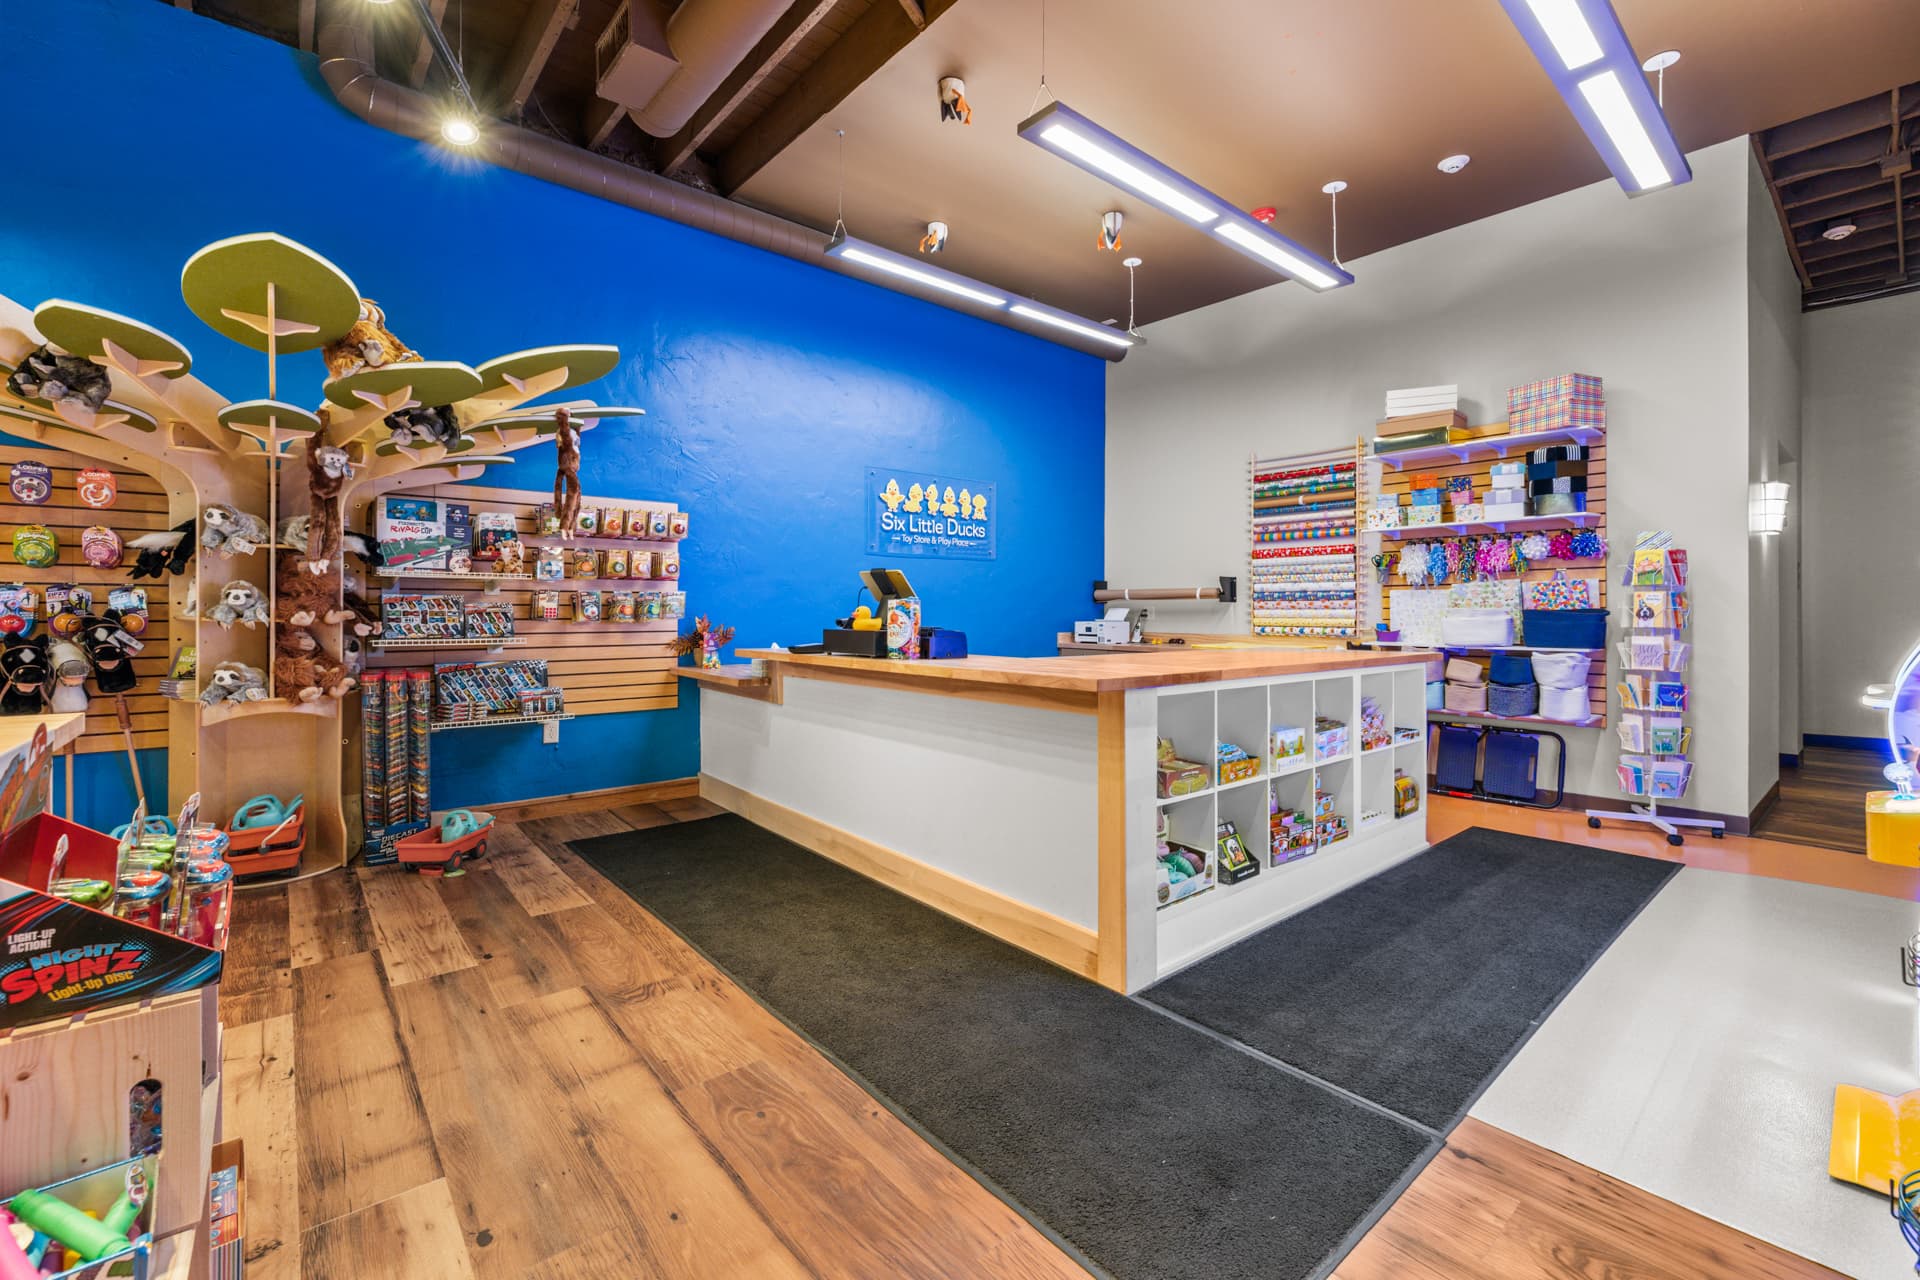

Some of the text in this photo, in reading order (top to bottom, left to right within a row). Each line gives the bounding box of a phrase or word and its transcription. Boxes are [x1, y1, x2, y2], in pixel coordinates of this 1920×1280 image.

[390, 525, 433, 535] RIVALS CUP
[881, 512, 986, 537] Six Little Ducks
[902, 534, 913, 544] Toy
[913, 535, 931, 544] Store
[937, 536, 951, 547] Play
[951, 538, 969, 547] Place
[381, 828, 418, 843] DIECAST
[8, 928, 56, 945] LIGHT-UP
[9, 939, 52, 954] ACTION!
[30, 943, 121, 971] NIGHT
[1, 950, 143, 1004] SPINZ
[48, 970, 134, 1001] Light-Up Disc
